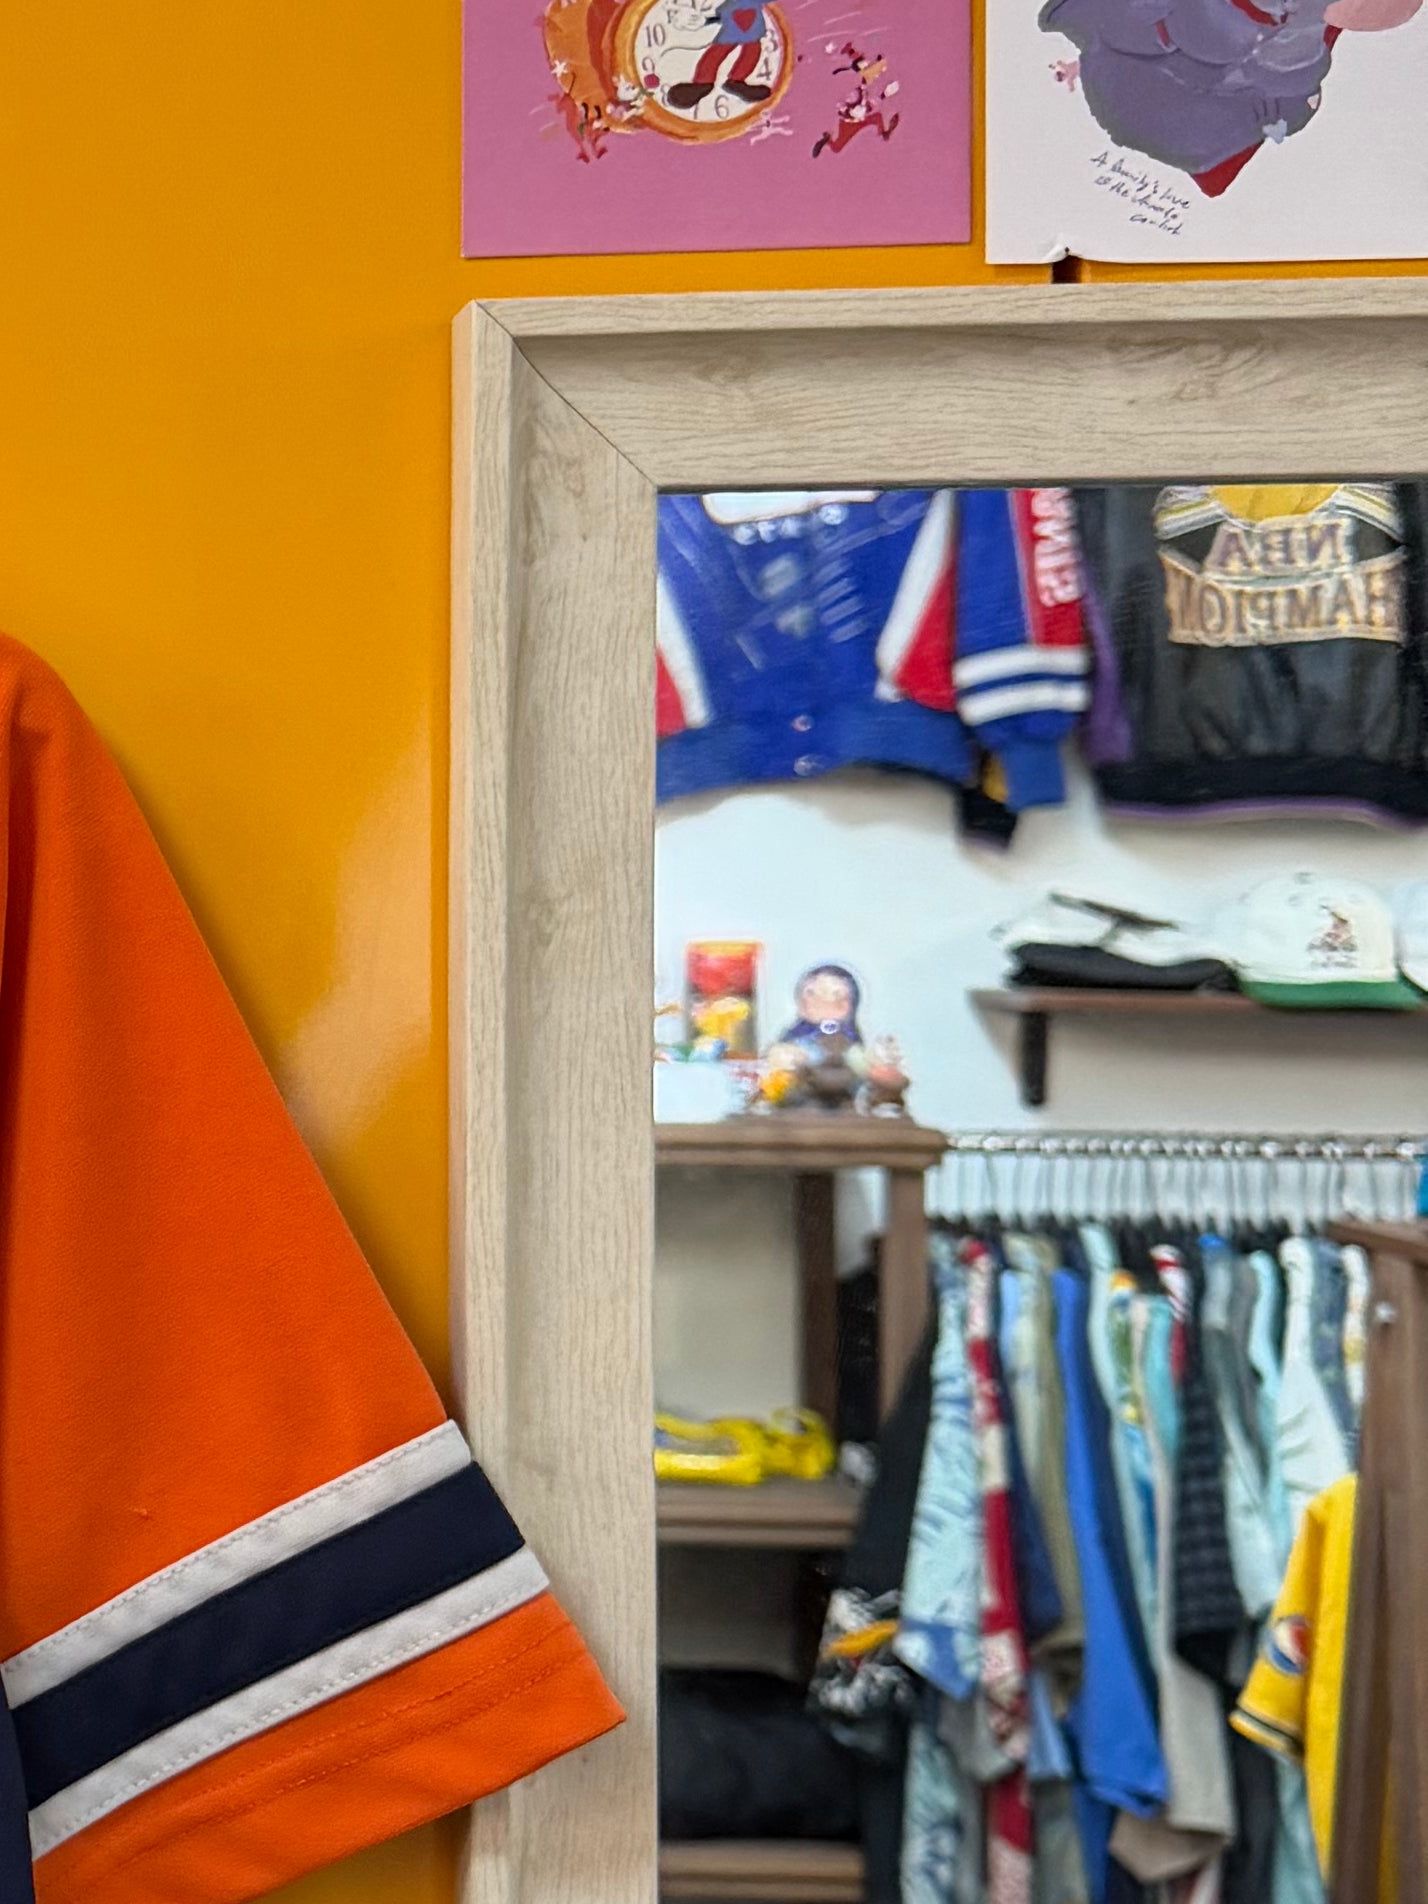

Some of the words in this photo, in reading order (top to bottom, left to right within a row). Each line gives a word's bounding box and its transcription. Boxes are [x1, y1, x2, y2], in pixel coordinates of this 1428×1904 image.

[645, 23, 666, 47] 10
[757, 56, 772, 81] 4
[715, 94, 730, 119] 6
